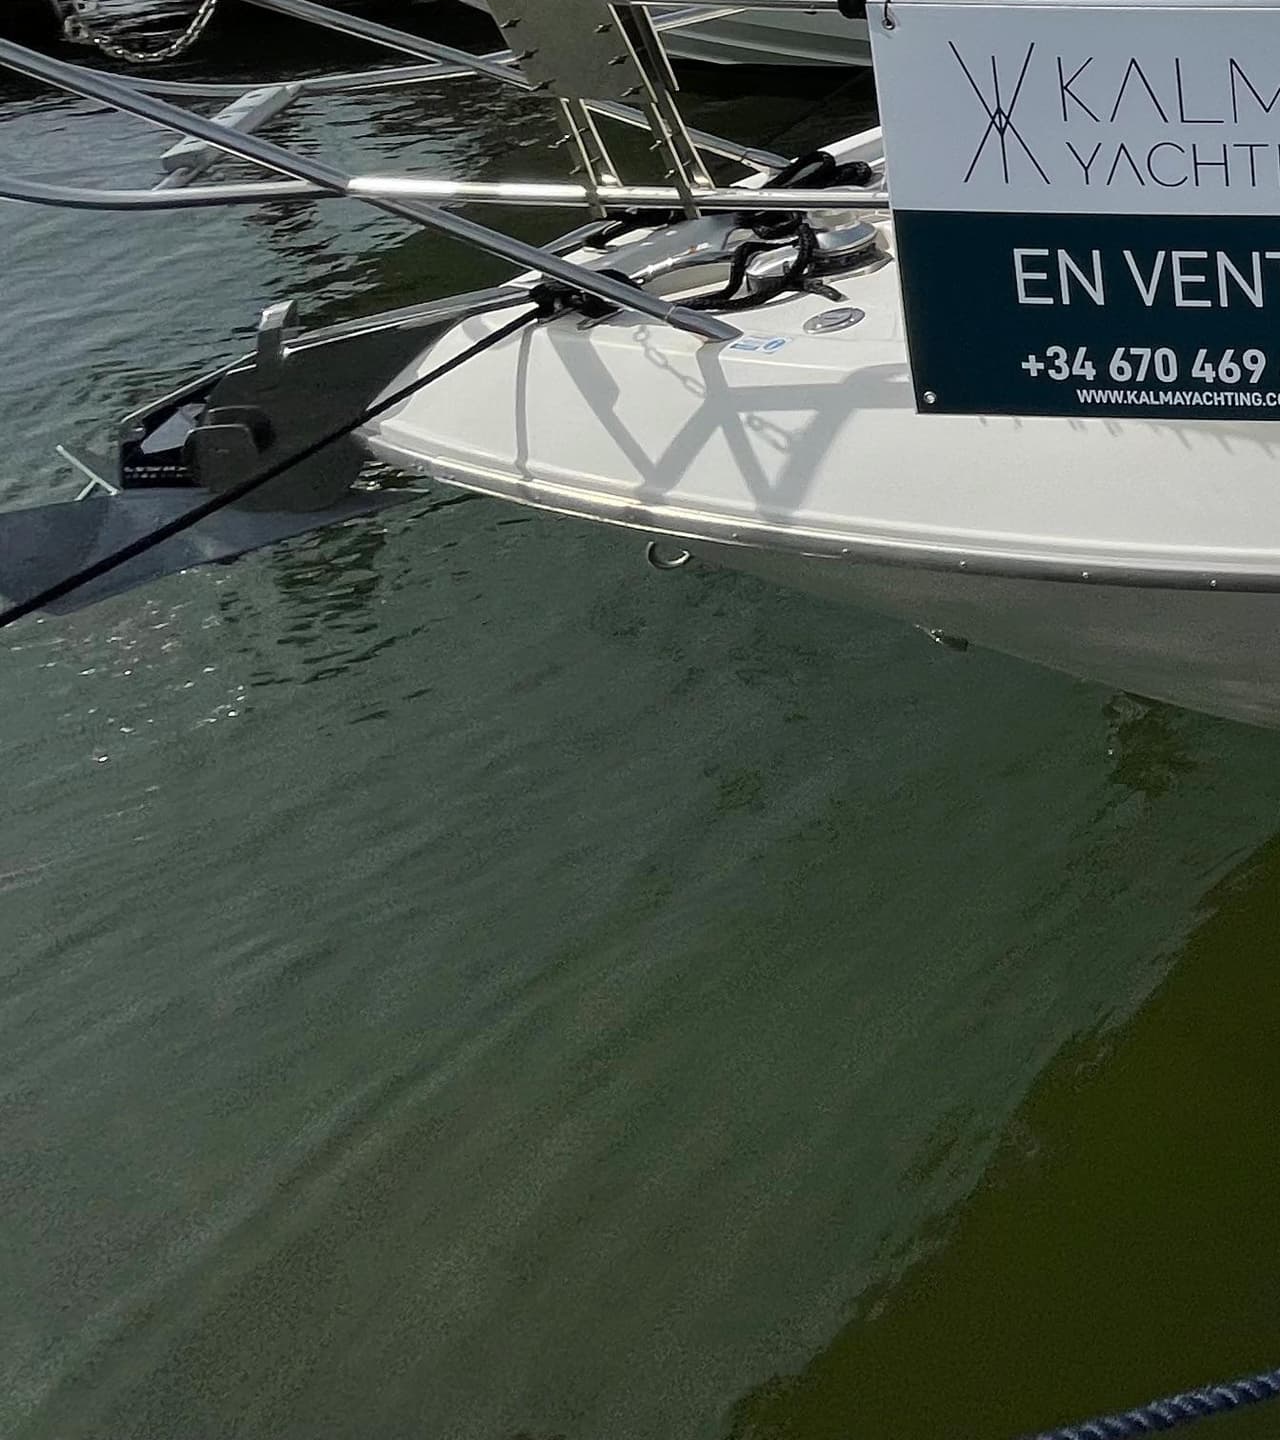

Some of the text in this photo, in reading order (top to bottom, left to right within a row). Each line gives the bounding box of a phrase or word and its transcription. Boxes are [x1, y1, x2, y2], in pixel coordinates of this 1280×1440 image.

[1013, 248, 1105, 305] EN
[1021, 345, 1096, 381] +34
[1109, 347, 1178, 383] 670
[1191, 348, 1266, 384] 469
